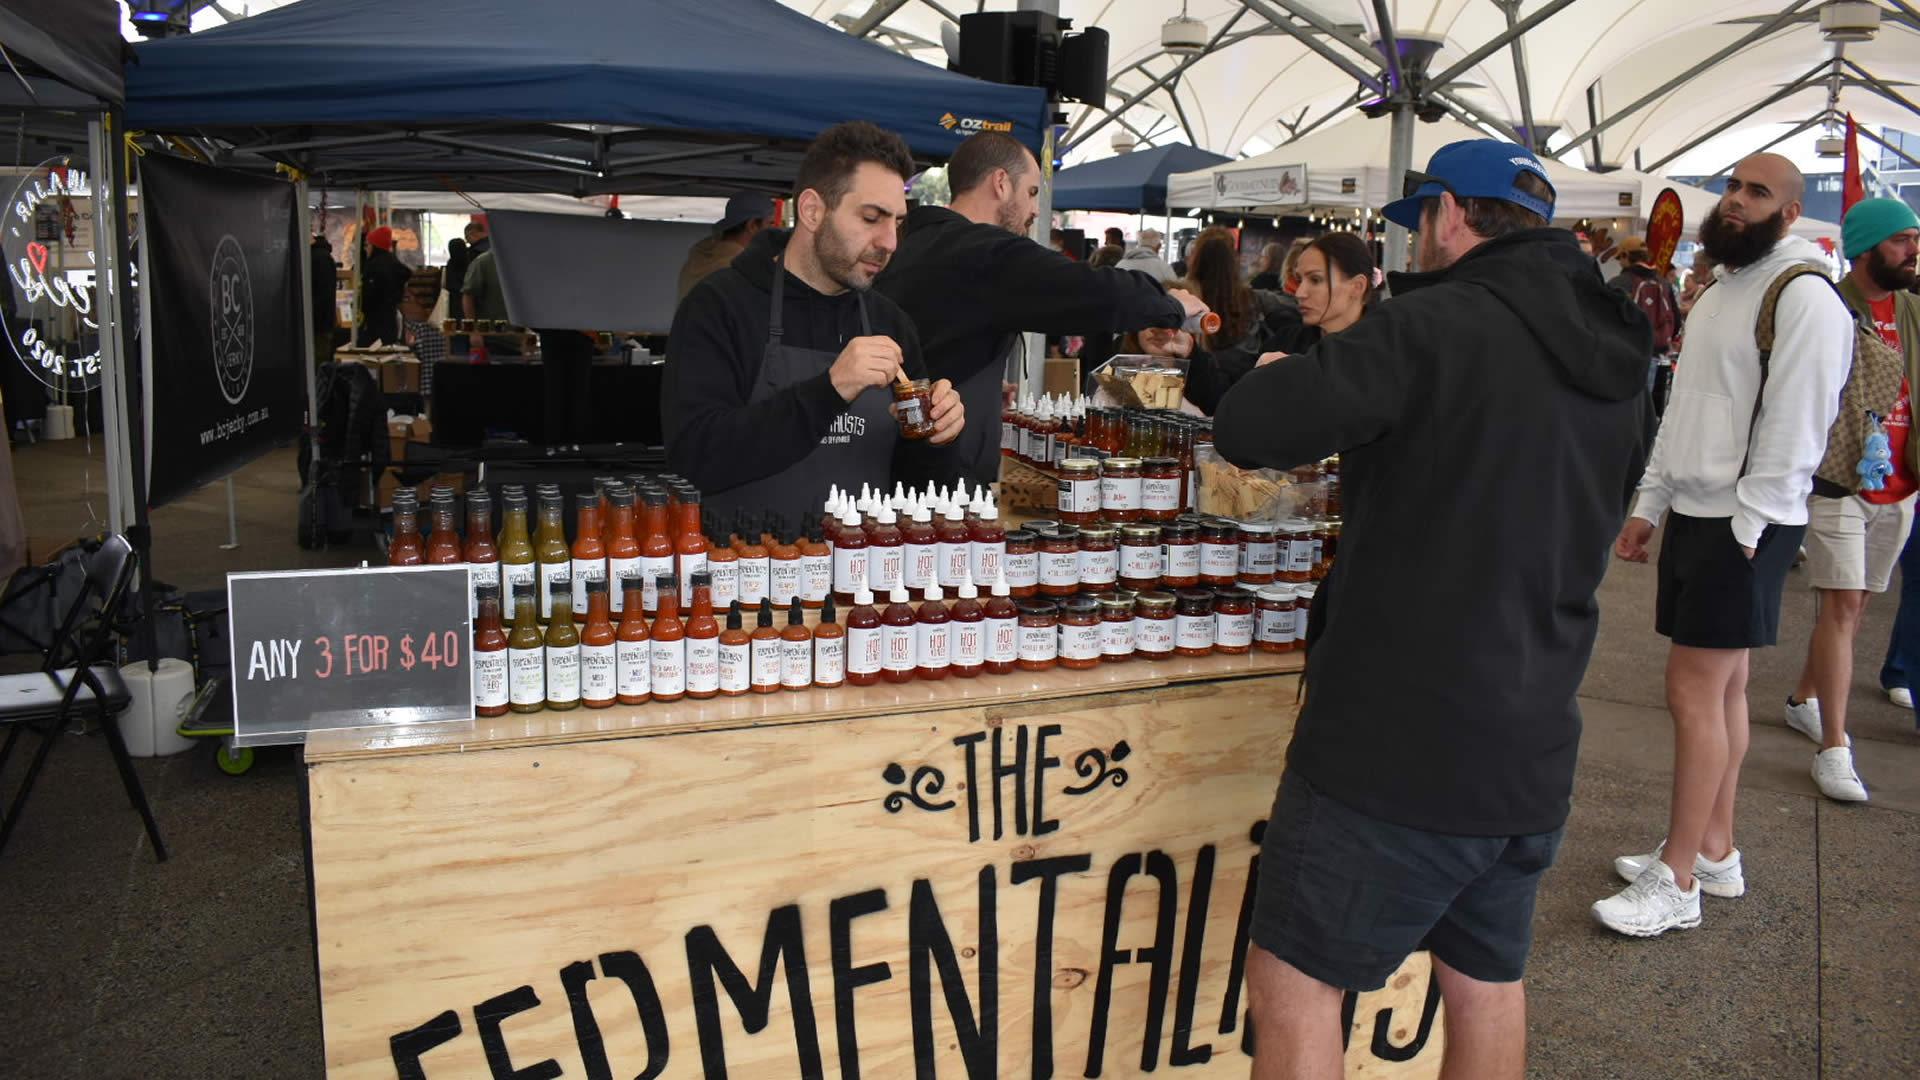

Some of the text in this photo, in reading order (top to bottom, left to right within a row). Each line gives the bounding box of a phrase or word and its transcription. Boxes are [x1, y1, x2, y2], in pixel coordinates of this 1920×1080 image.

[221, 274, 240, 314] BC
[850, 559, 866, 574] HOT
[884, 558, 900, 572] HOT
[917, 555, 934, 569] HOT
[951, 554, 967, 568] HOT
[981, 553, 998, 567] HOT
[890, 637, 909, 651] HOT
[929, 634, 946, 649] HOT
[960, 633, 977, 647] HOT
[996, 629, 1014, 644] HOT
[866, 638, 881, 653] HOT
[247, 638, 302, 681] ANY
[314, 636, 333, 679] 3
[344, 634, 390, 676] FOR
[953, 724, 1062, 843] THE
